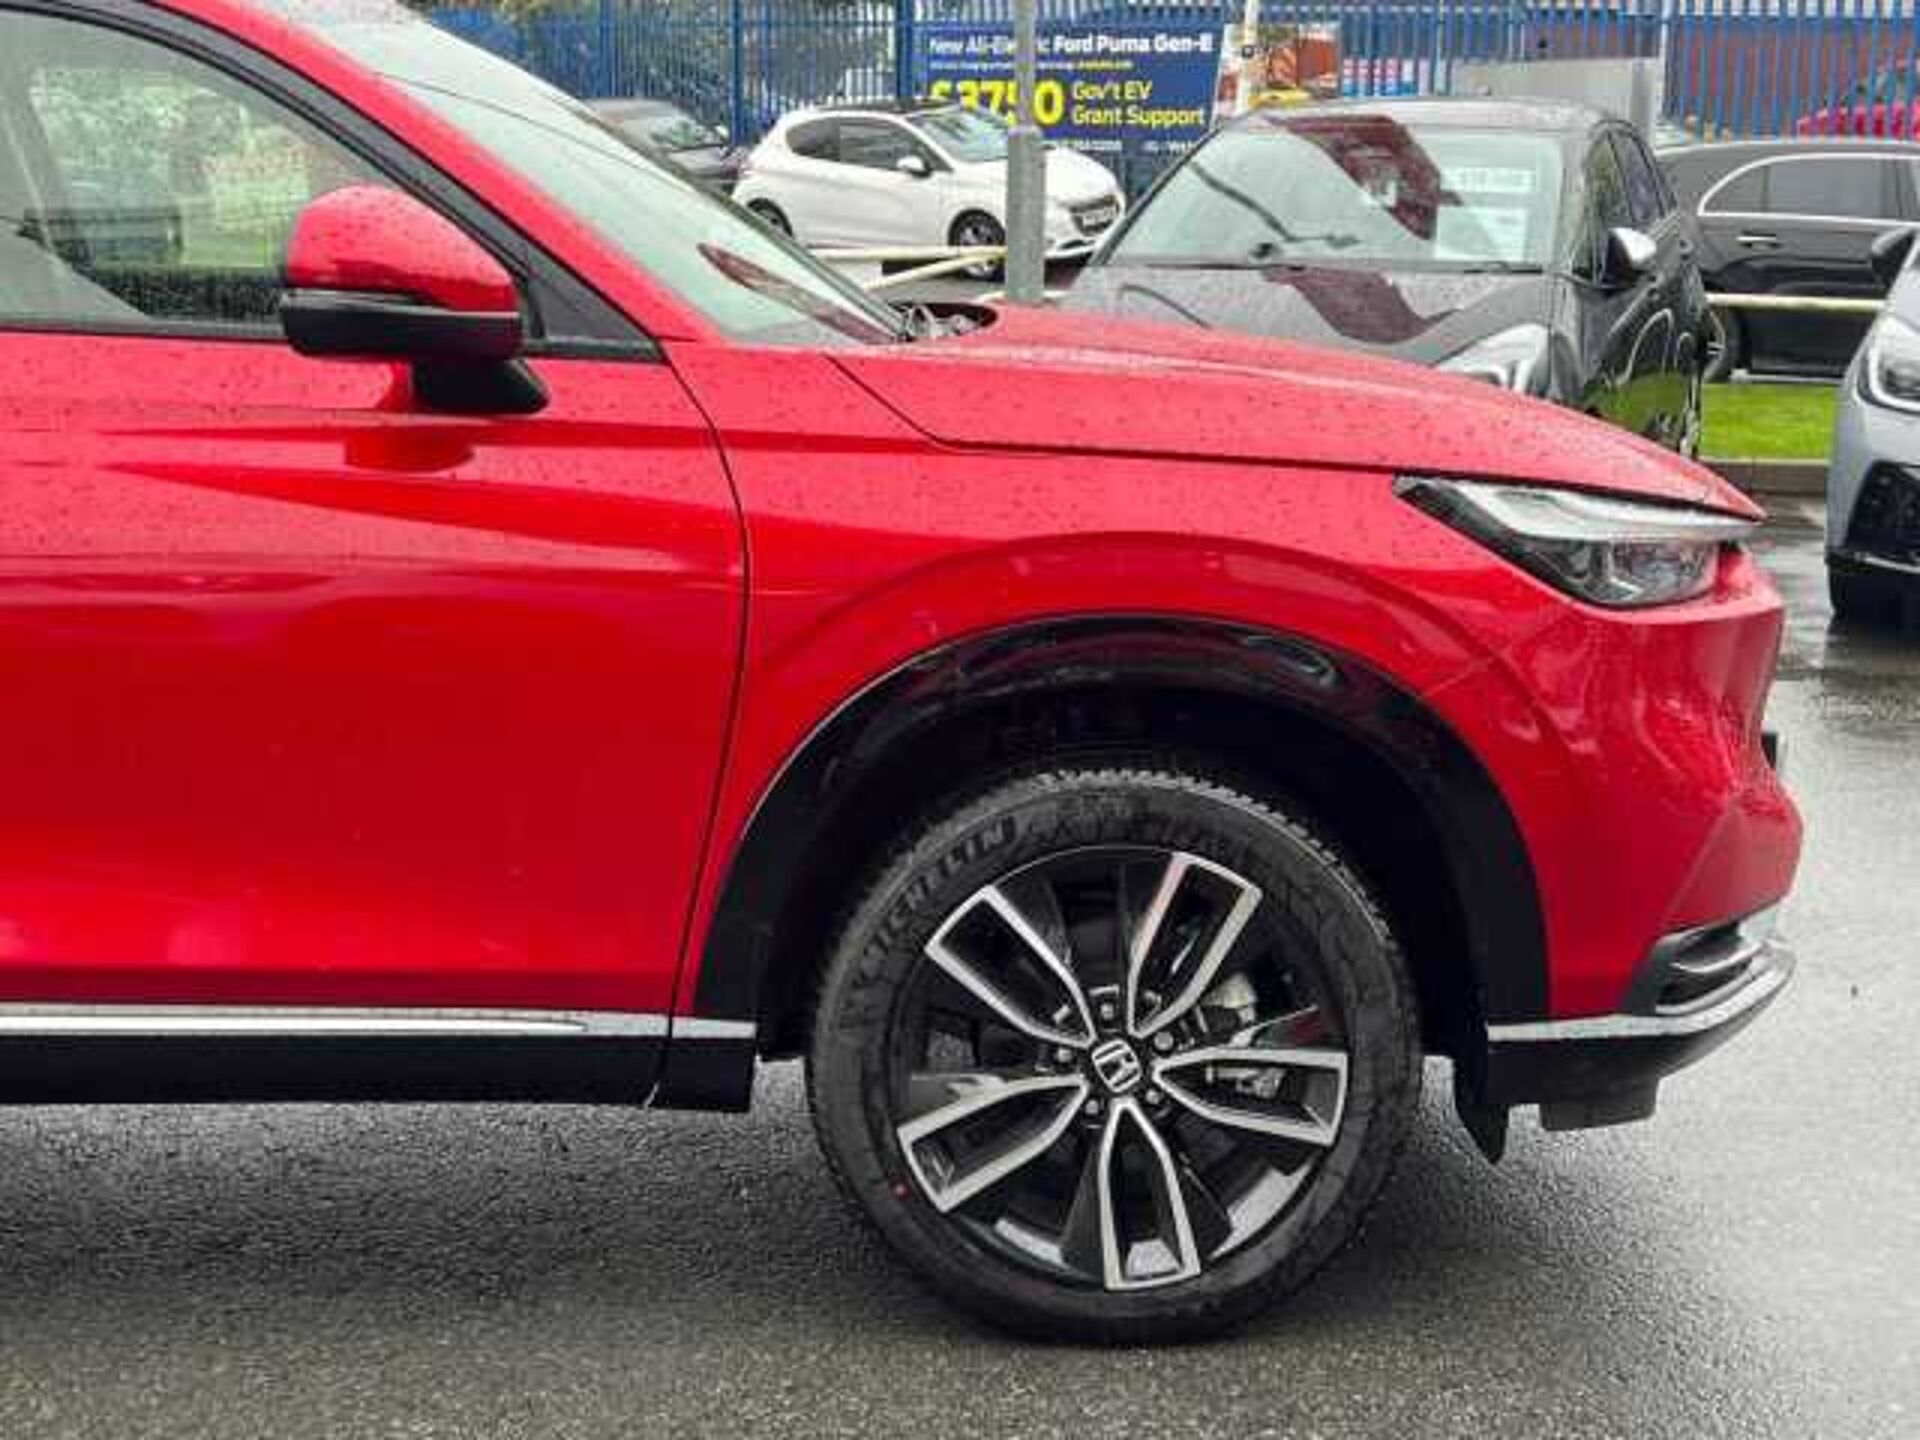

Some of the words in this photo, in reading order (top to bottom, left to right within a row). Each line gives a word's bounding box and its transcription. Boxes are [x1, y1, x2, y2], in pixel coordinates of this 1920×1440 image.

[966, 34, 1050, 53] All-Eleic
[1053, 34, 1093, 53] Ford
[1097, 34, 1150, 53] Puma
[1153, 32, 1213, 52] Gen-E
[1072, 80, 1121, 100] Gov't
[1123, 80, 1153, 100] EV
[1072, 105, 1123, 125] Grant
[1125, 104, 1204, 129] Support
